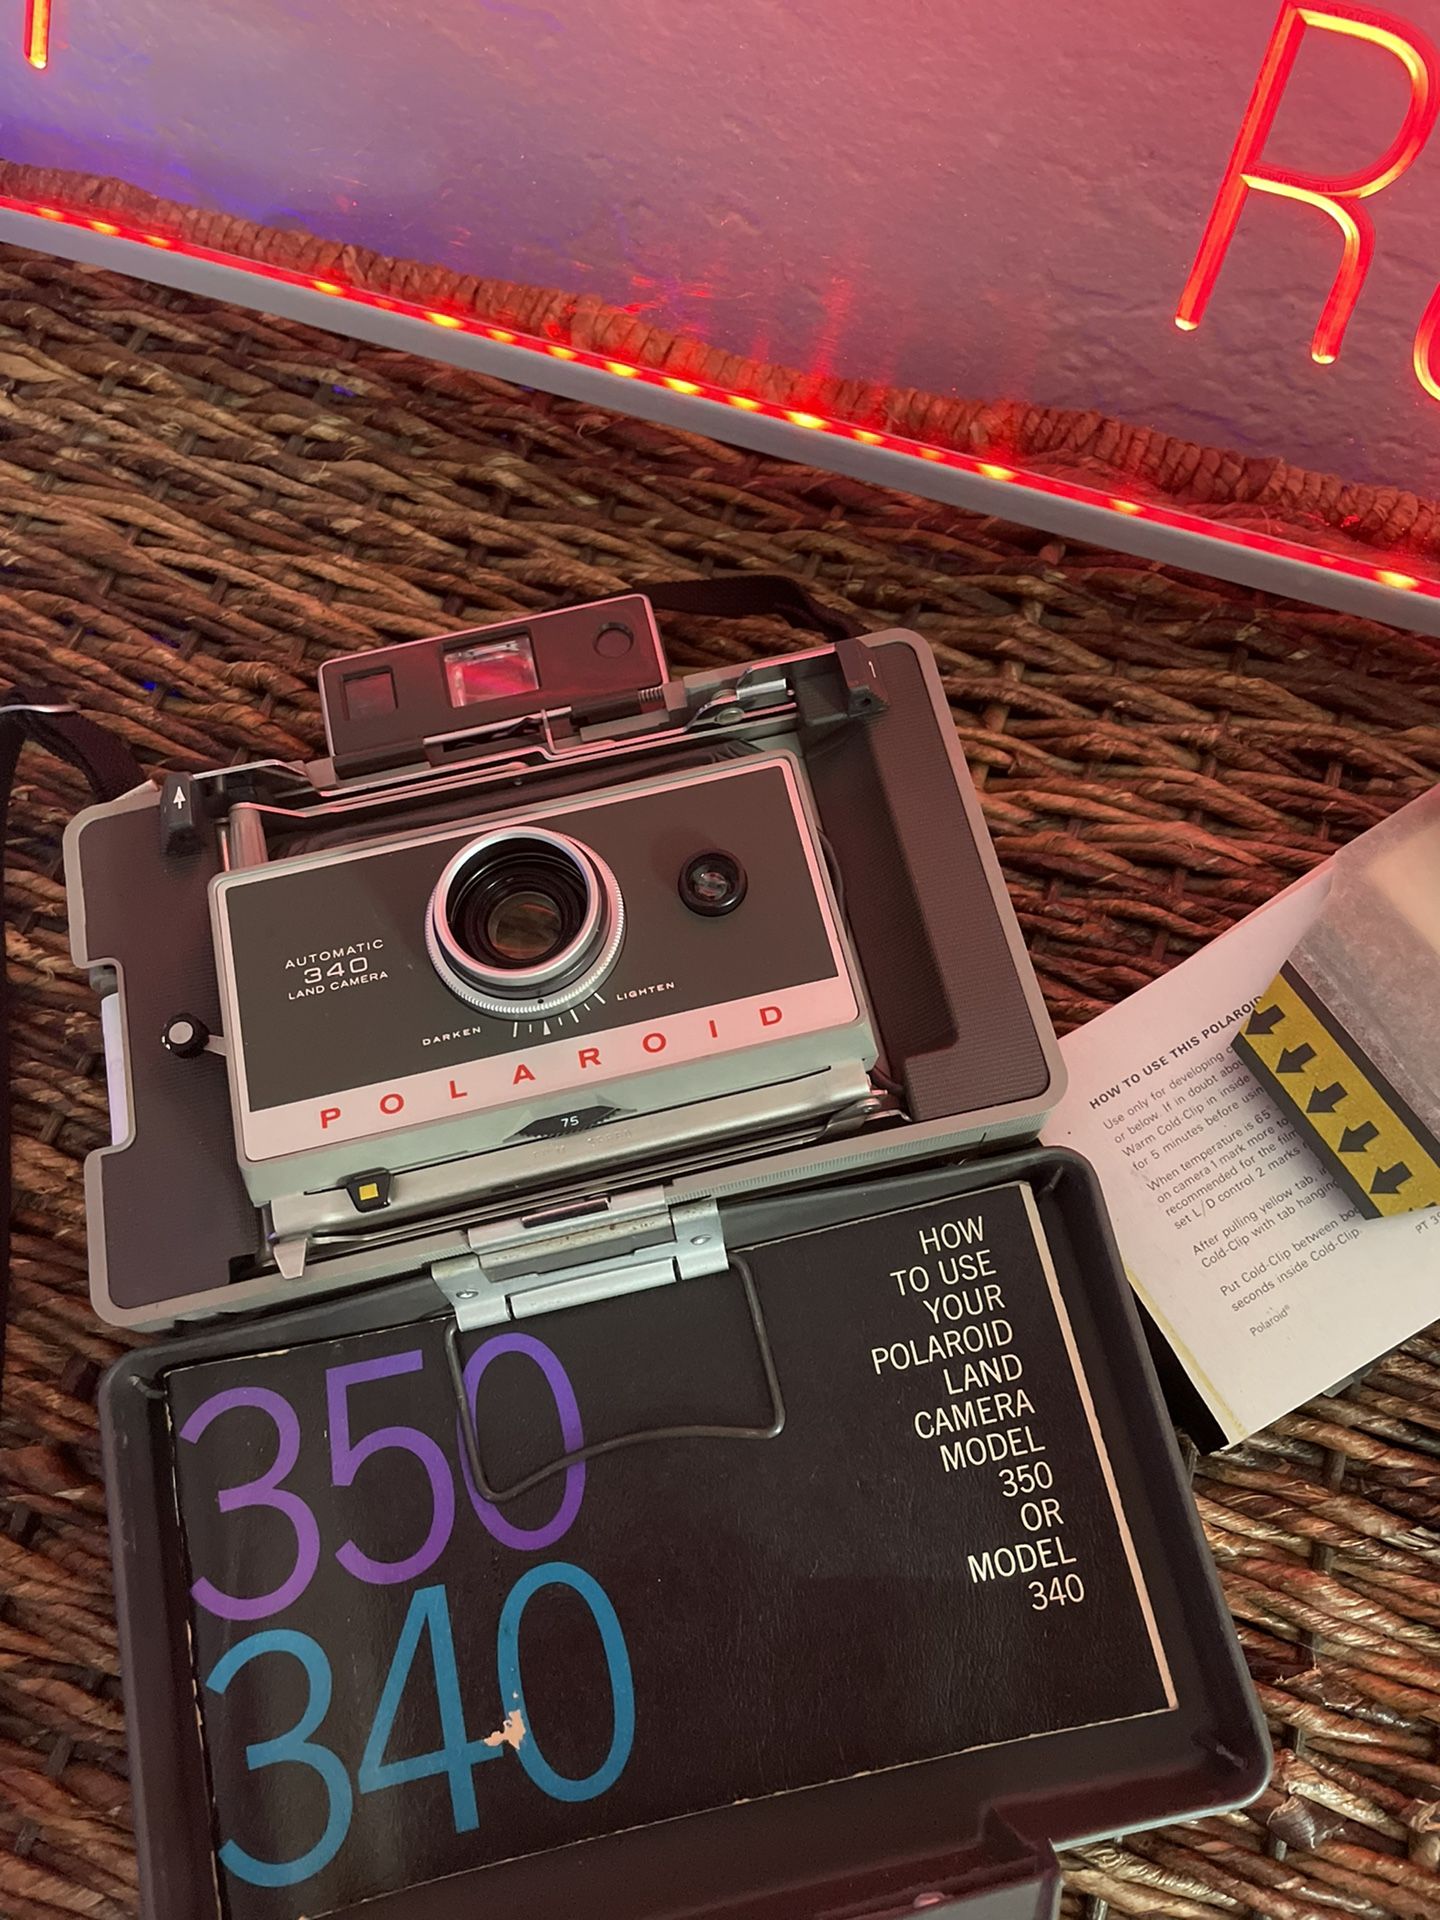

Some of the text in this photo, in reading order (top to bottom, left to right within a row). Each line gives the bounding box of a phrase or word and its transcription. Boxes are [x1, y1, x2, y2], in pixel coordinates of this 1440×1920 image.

[284, 938, 384, 970] AUTOMATIC
[303, 956, 368, 985] 340
[288, 970, 389, 1001] LAND CAMERA
[616, 981, 676, 1001] LIGHTEN
[422, 1026, 482, 1047] DARKEN
[320, 1005, 784, 1129] POLAROID
[1088, 1084, 1120, 1109] HOW
[1121, 1073, 1140, 1087] TO
[1141, 1055, 1168, 1075] USE
[1168, 1036, 1200, 1058] THIS
[1102, 1052, 1224, 1129] Use only for developing
[560, 1115, 579, 1128] 75
[1114, 1132, 1125, 1143] or
[1161, 1100, 1172, 1112] If
[1172, 1095, 1186, 1106] in
[1187, 1074, 1218, 1097] doubt
[1120, 1074, 1250, 1156] Warm Cold-Clip in inside
[1132, 1157, 1148, 1171] for
[1149, 1148, 1160, 1159] 5
[1162, 1123, 1204, 1152] minutes
[1203, 1101, 1239, 1126] before
[1145, 1168, 1180, 1191] When
[1179, 1128, 1243, 1171] temperature
[1242, 1121, 1254, 1132] is
[1156, 1117, 1288, 1203] on camera 1 mark more to
[1165, 1164, 1238, 1216] recommended
[1238, 1155, 1255, 1169] for
[1257, 1143, 1276, 1157] the
[1173, 1214, 1192, 1229] set
[1217, 1172, 1254, 1202] control
[1254, 1166, 1266, 1177] 2
[1267, 1147, 1300, 1170] marks
[919, 1215, 985, 1255] HOW
[1192, 1234, 1219, 1255] After
[1221, 1211, 1258, 1239] pulling
[1258, 1187, 1292, 1215] yellow
[1201, 1234, 1249, 1268] Cold-Clip
[1250, 1217, 1275, 1236] with
[1276, 1205, 1295, 1220] tab
[1415, 1221, 1429, 1234] PT
[890, 1249, 997, 1297] TO USE
[1219, 1280, 1241, 1296] Put
[1240, 1249, 1291, 1283] Cold-Clip
[1290, 1219, 1338, 1251] between
[923, 1284, 1005, 1325] YOUR
[1231, 1280, 1275, 1311] seconds
[1274, 1259, 1309, 1283] inside
[871, 1319, 1014, 1374] POLAROID
[943, 1354, 1023, 1395] LAND
[914, 1389, 1035, 1439] CAMERA
[940, 1426, 1046, 1472] MODEL
[179, 1332, 587, 1621] 350
[999, 1461, 1054, 1497] 350
[1020, 1498, 1064, 1531] OR
[967, 1536, 1077, 1583] MODEL
[1028, 1574, 1085, 1611] 340
[205, 1561, 636, 1888] 340
